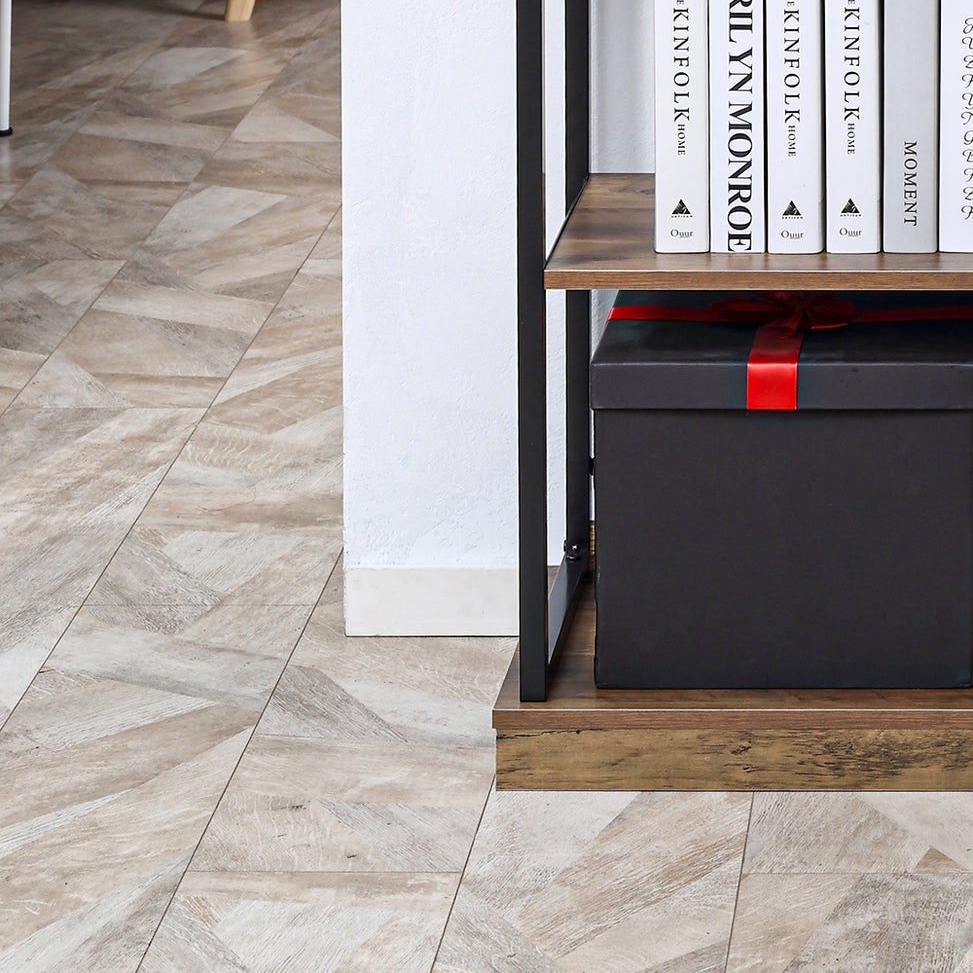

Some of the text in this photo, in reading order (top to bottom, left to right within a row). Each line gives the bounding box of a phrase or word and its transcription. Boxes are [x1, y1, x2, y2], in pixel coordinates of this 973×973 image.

[672, 7, 690, 122] KINFOLK
[783, 9, 801, 123] KINFOLK
[843, 7, 861, 121] KINFOLK
[677, 123, 686, 156] HOME
[787, 125, 797, 157] HOME
[847, 123, 856, 155] HOME
[727, 101, 753, 252] MONROE
[903, 141, 918, 227] MOMENT
[670, 228, 693, 238] Ouur
[780, 229, 804, 239] Ouur
[839, 227, 862, 237] Ouur
